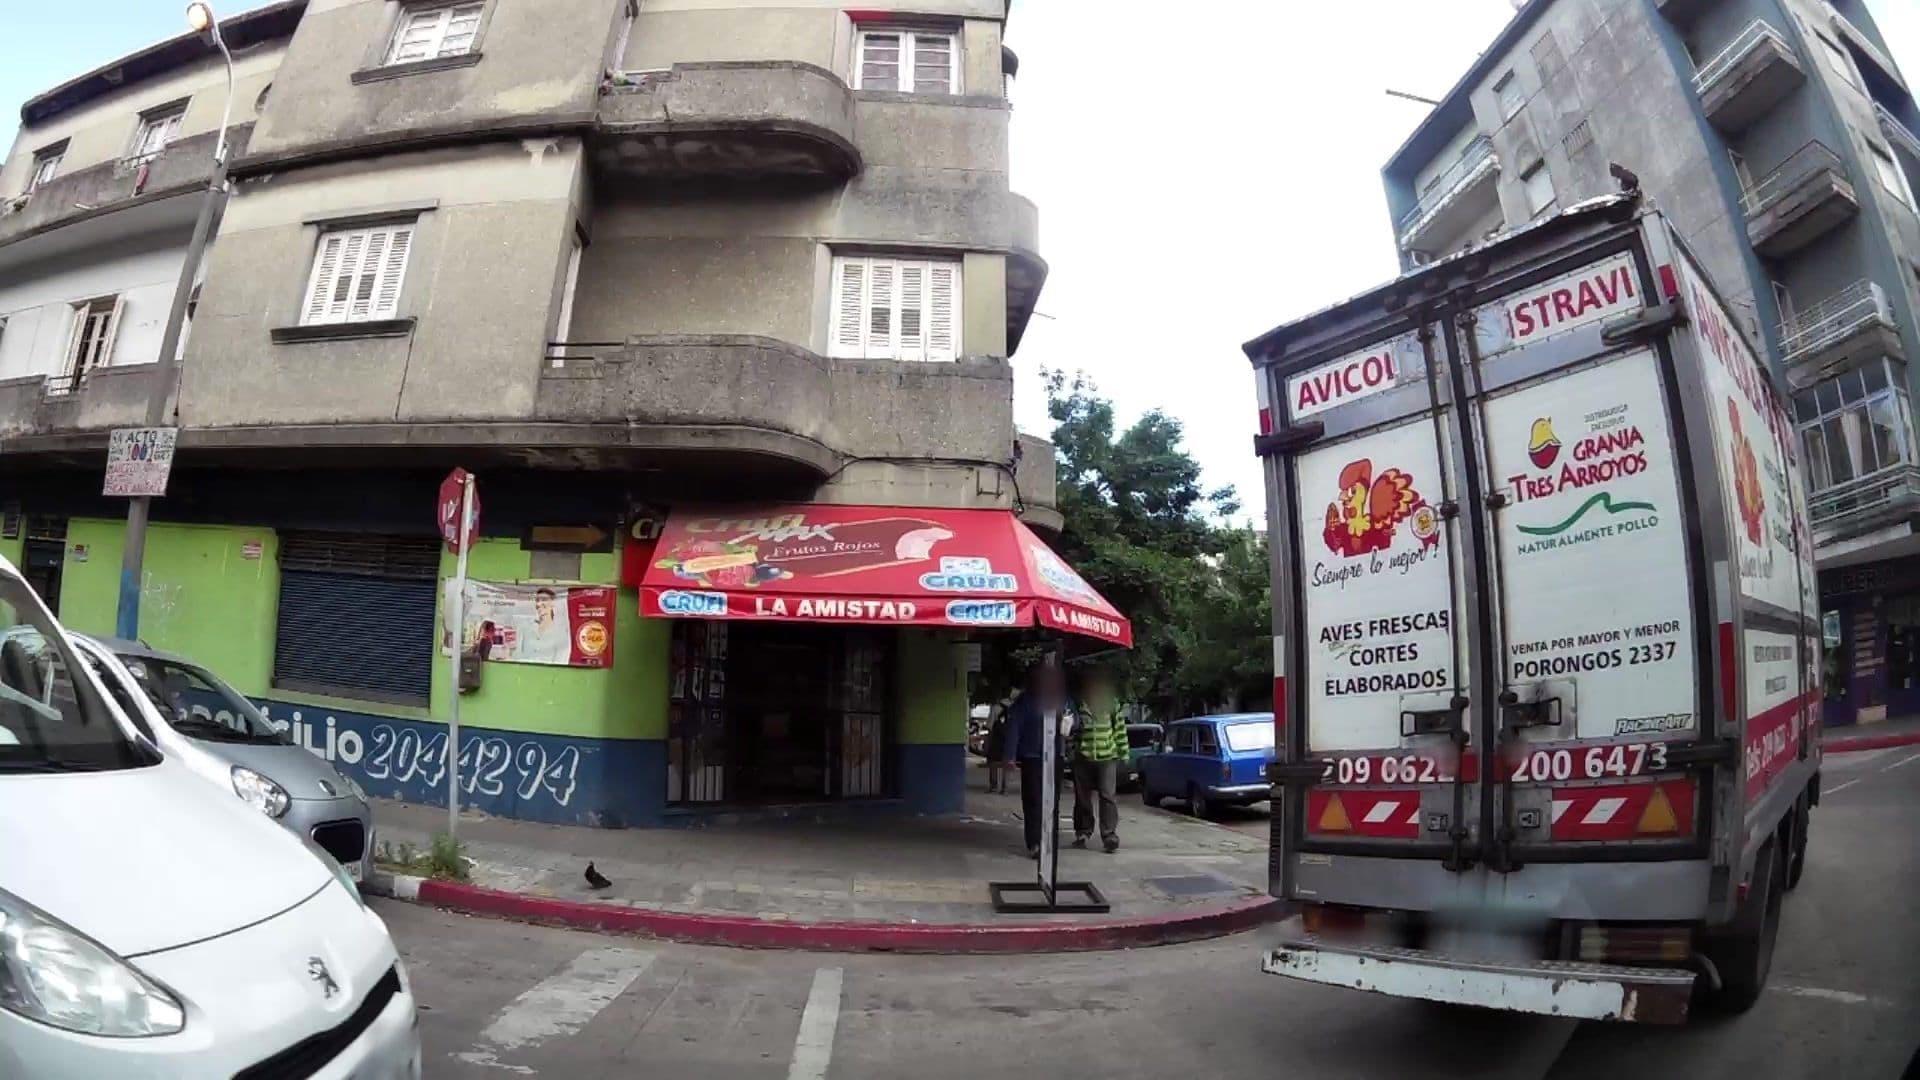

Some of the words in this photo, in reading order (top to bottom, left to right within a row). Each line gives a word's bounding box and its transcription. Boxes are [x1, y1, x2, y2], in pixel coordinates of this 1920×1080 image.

[1573, 425, 1645, 461] GRANJA
[1508, 474, 1555, 503] TRES
[1557, 450, 1648, 492] ARROYOS
[772, 545, 828, 557] Frutos
[833, 541, 881, 553] Rojos
[1517, 525, 1615, 555] NATURALMENTE
[1616, 515, 1659, 535] POLLO
[923, 574, 1014, 590] CRUFI
[1311, 561, 1364, 589] Siempre
[1369, 549, 1383, 574] lo
[1388, 550, 1426, 575] mejor
[755, 597, 789, 616] LA
[796, 599, 917, 620] AMISTAD
[1050, 605, 1069, 624] LA
[1070, 609, 1122, 637] AMISTAD
[1320, 622, 1363, 643] AVES
[1369, 610, 1449, 637] FRESCAS
[1511, 641, 1549, 656] VENTA
[1551, 637, 1575, 650] POR
[1577, 630, 1621, 645] MAYOR
[1623, 629, 1632, 640] Y
[1635, 620, 1681, 638] MENOR
[1350, 643, 1419, 666] CORTES
[1513, 648, 1623, 679] PORONGOS
[1629, 641, 1677, 665] 2337
[1325, 669, 1447, 696] ELABORADOS
[1584, 742, 1668, 778] 6473
